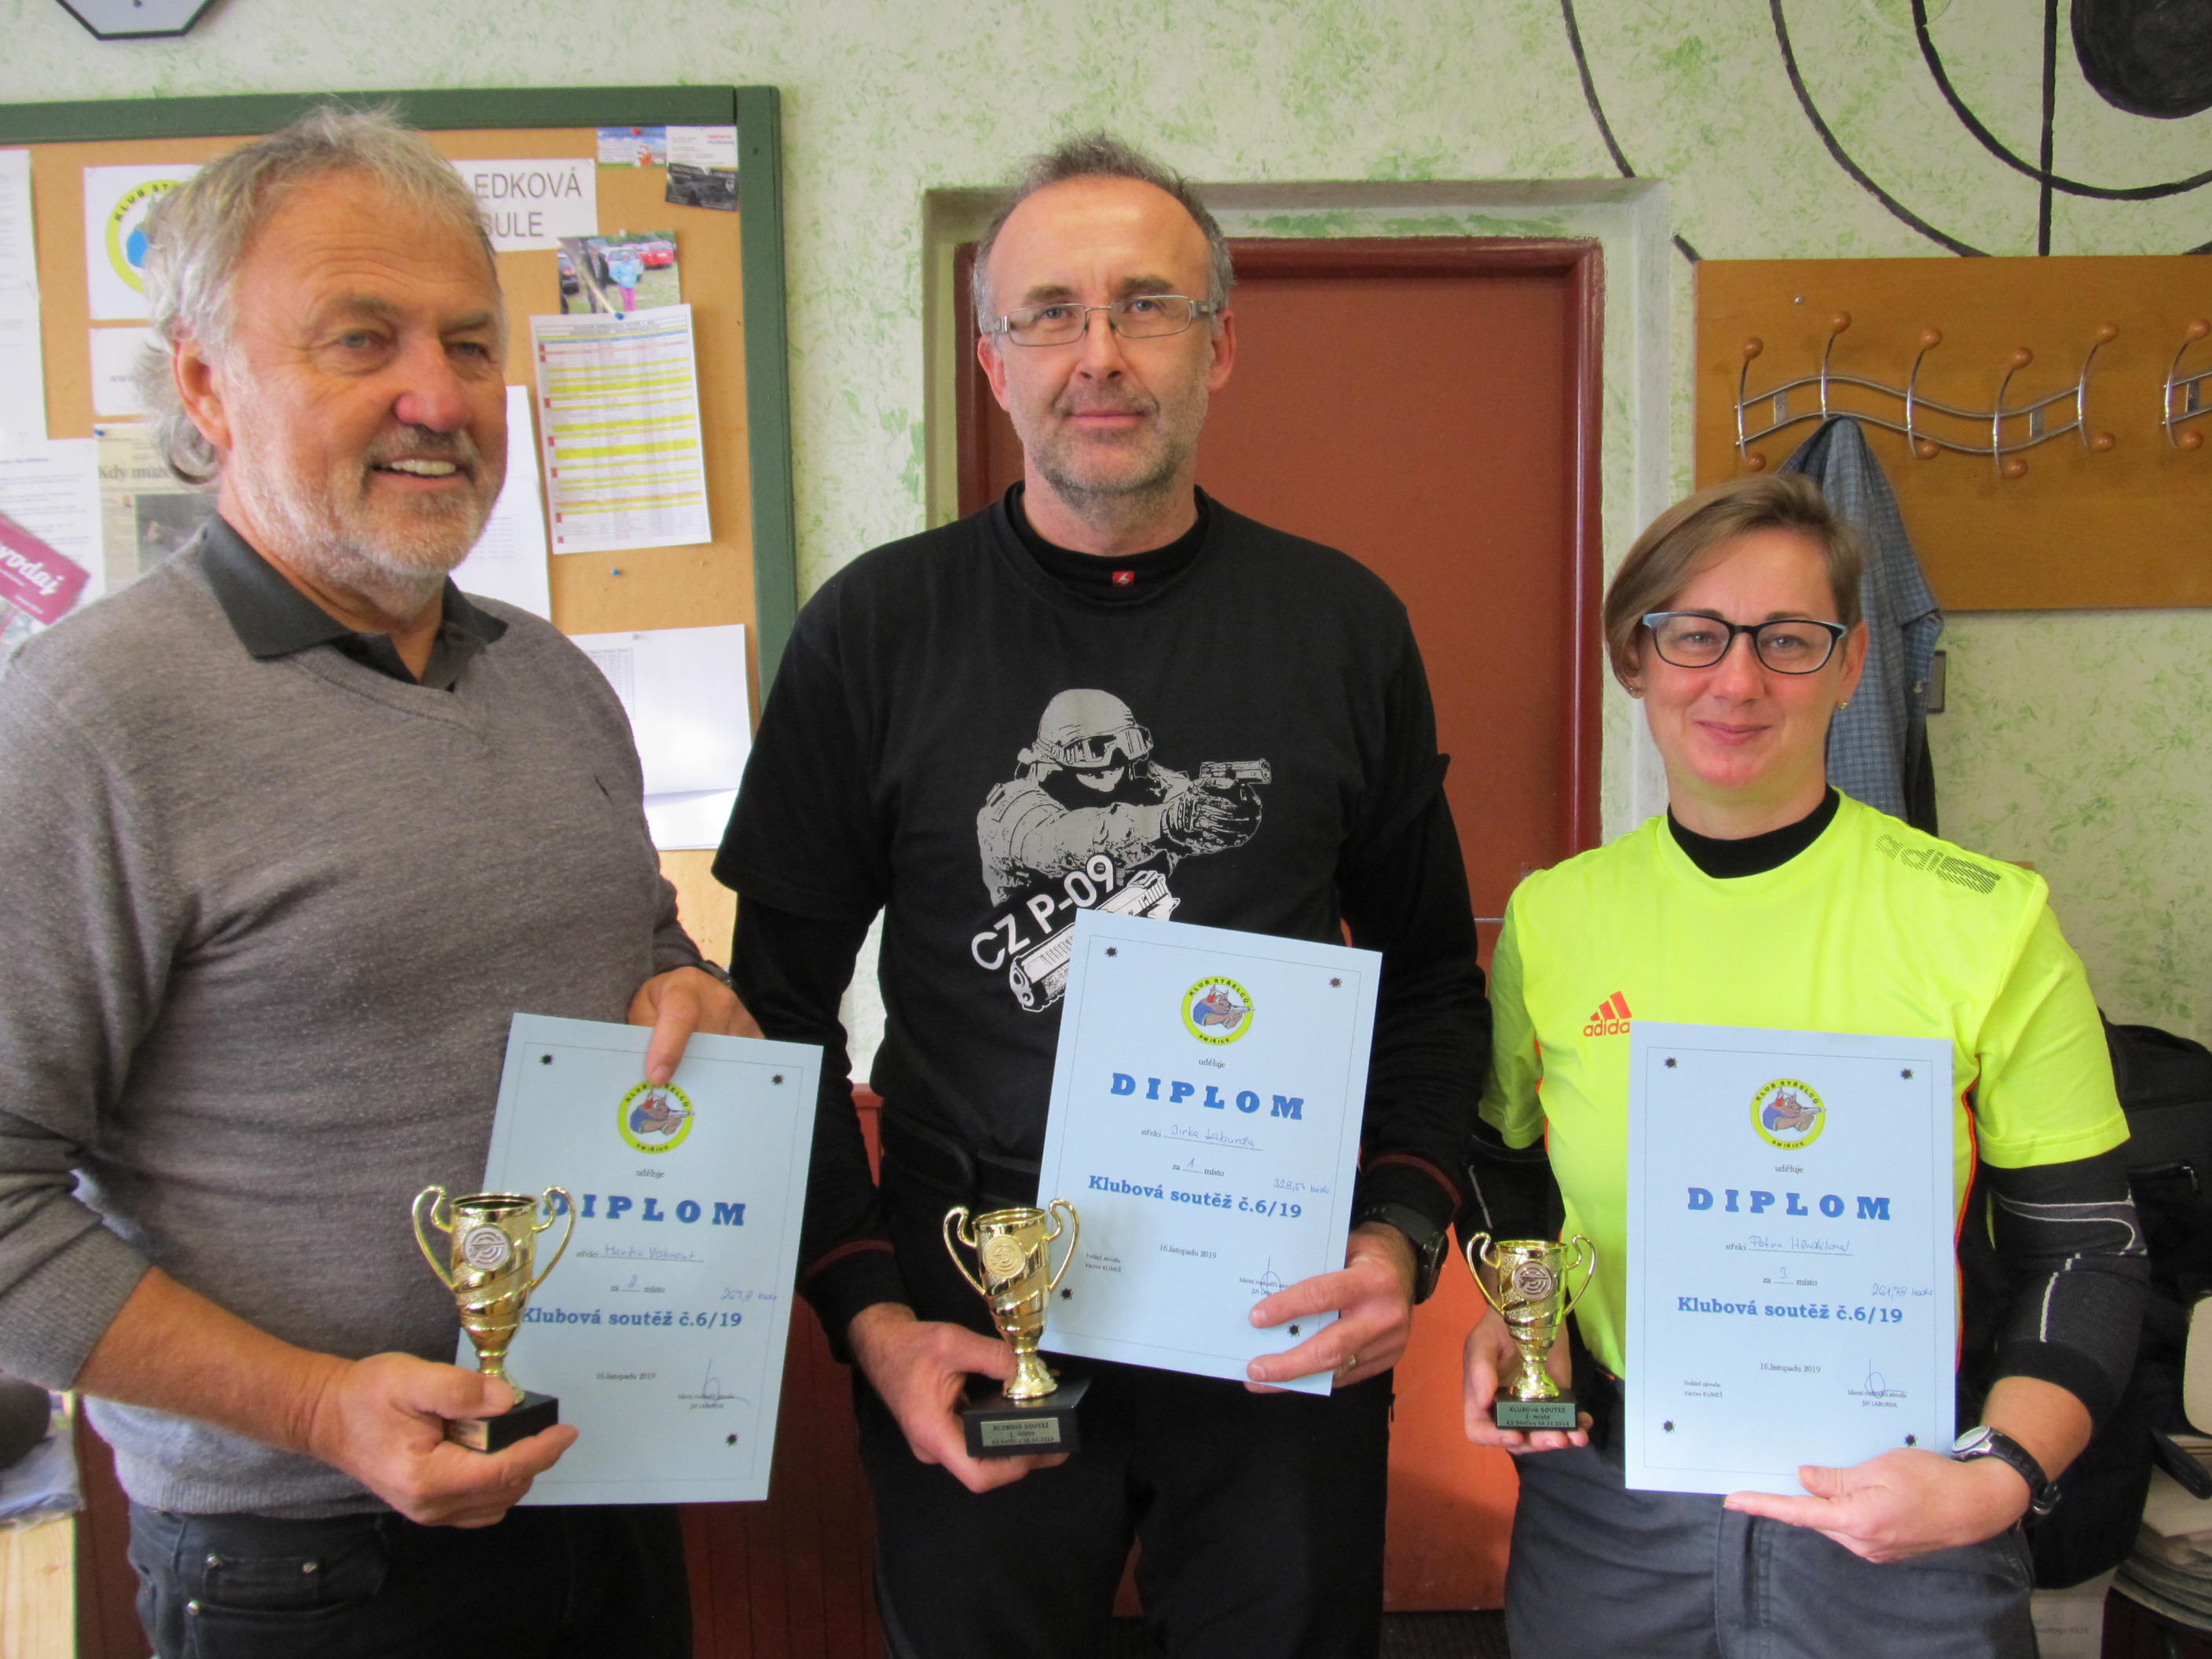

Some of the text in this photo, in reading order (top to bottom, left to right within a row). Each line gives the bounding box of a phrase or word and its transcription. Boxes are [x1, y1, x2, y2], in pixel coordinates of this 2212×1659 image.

[474, 167, 582, 198] EDKOVÁ
[479, 211, 544, 237] BULE
[971, 855, 1114, 970] CZ P-09
[1188, 980, 1210, 996] KLUB
[1583, 1019, 1631, 1037] adida
[1199, 1058, 1226, 1069] uděluje
[1110, 1072, 1304, 1121] DIPLOM
[1188, 1157, 1195, 1168] 1
[1203, 1168, 1225, 1177] místo
[1774, 1164, 1804, 1174] uděluje
[1088, 1175, 1302, 1218] Klubová soutěž č.6/19
[1687, 1187, 1890, 1221] DIPLOM
[543, 1192, 745, 1226] DIPLOM
[1779, 1266, 1787, 1279] 3
[522, 1307, 742, 1328] Klubová soutěž č.6/19
[1678, 1297, 1903, 1324] Klubová soutěž č.6/19
[1804, 1364, 1821, 1373] 2019
